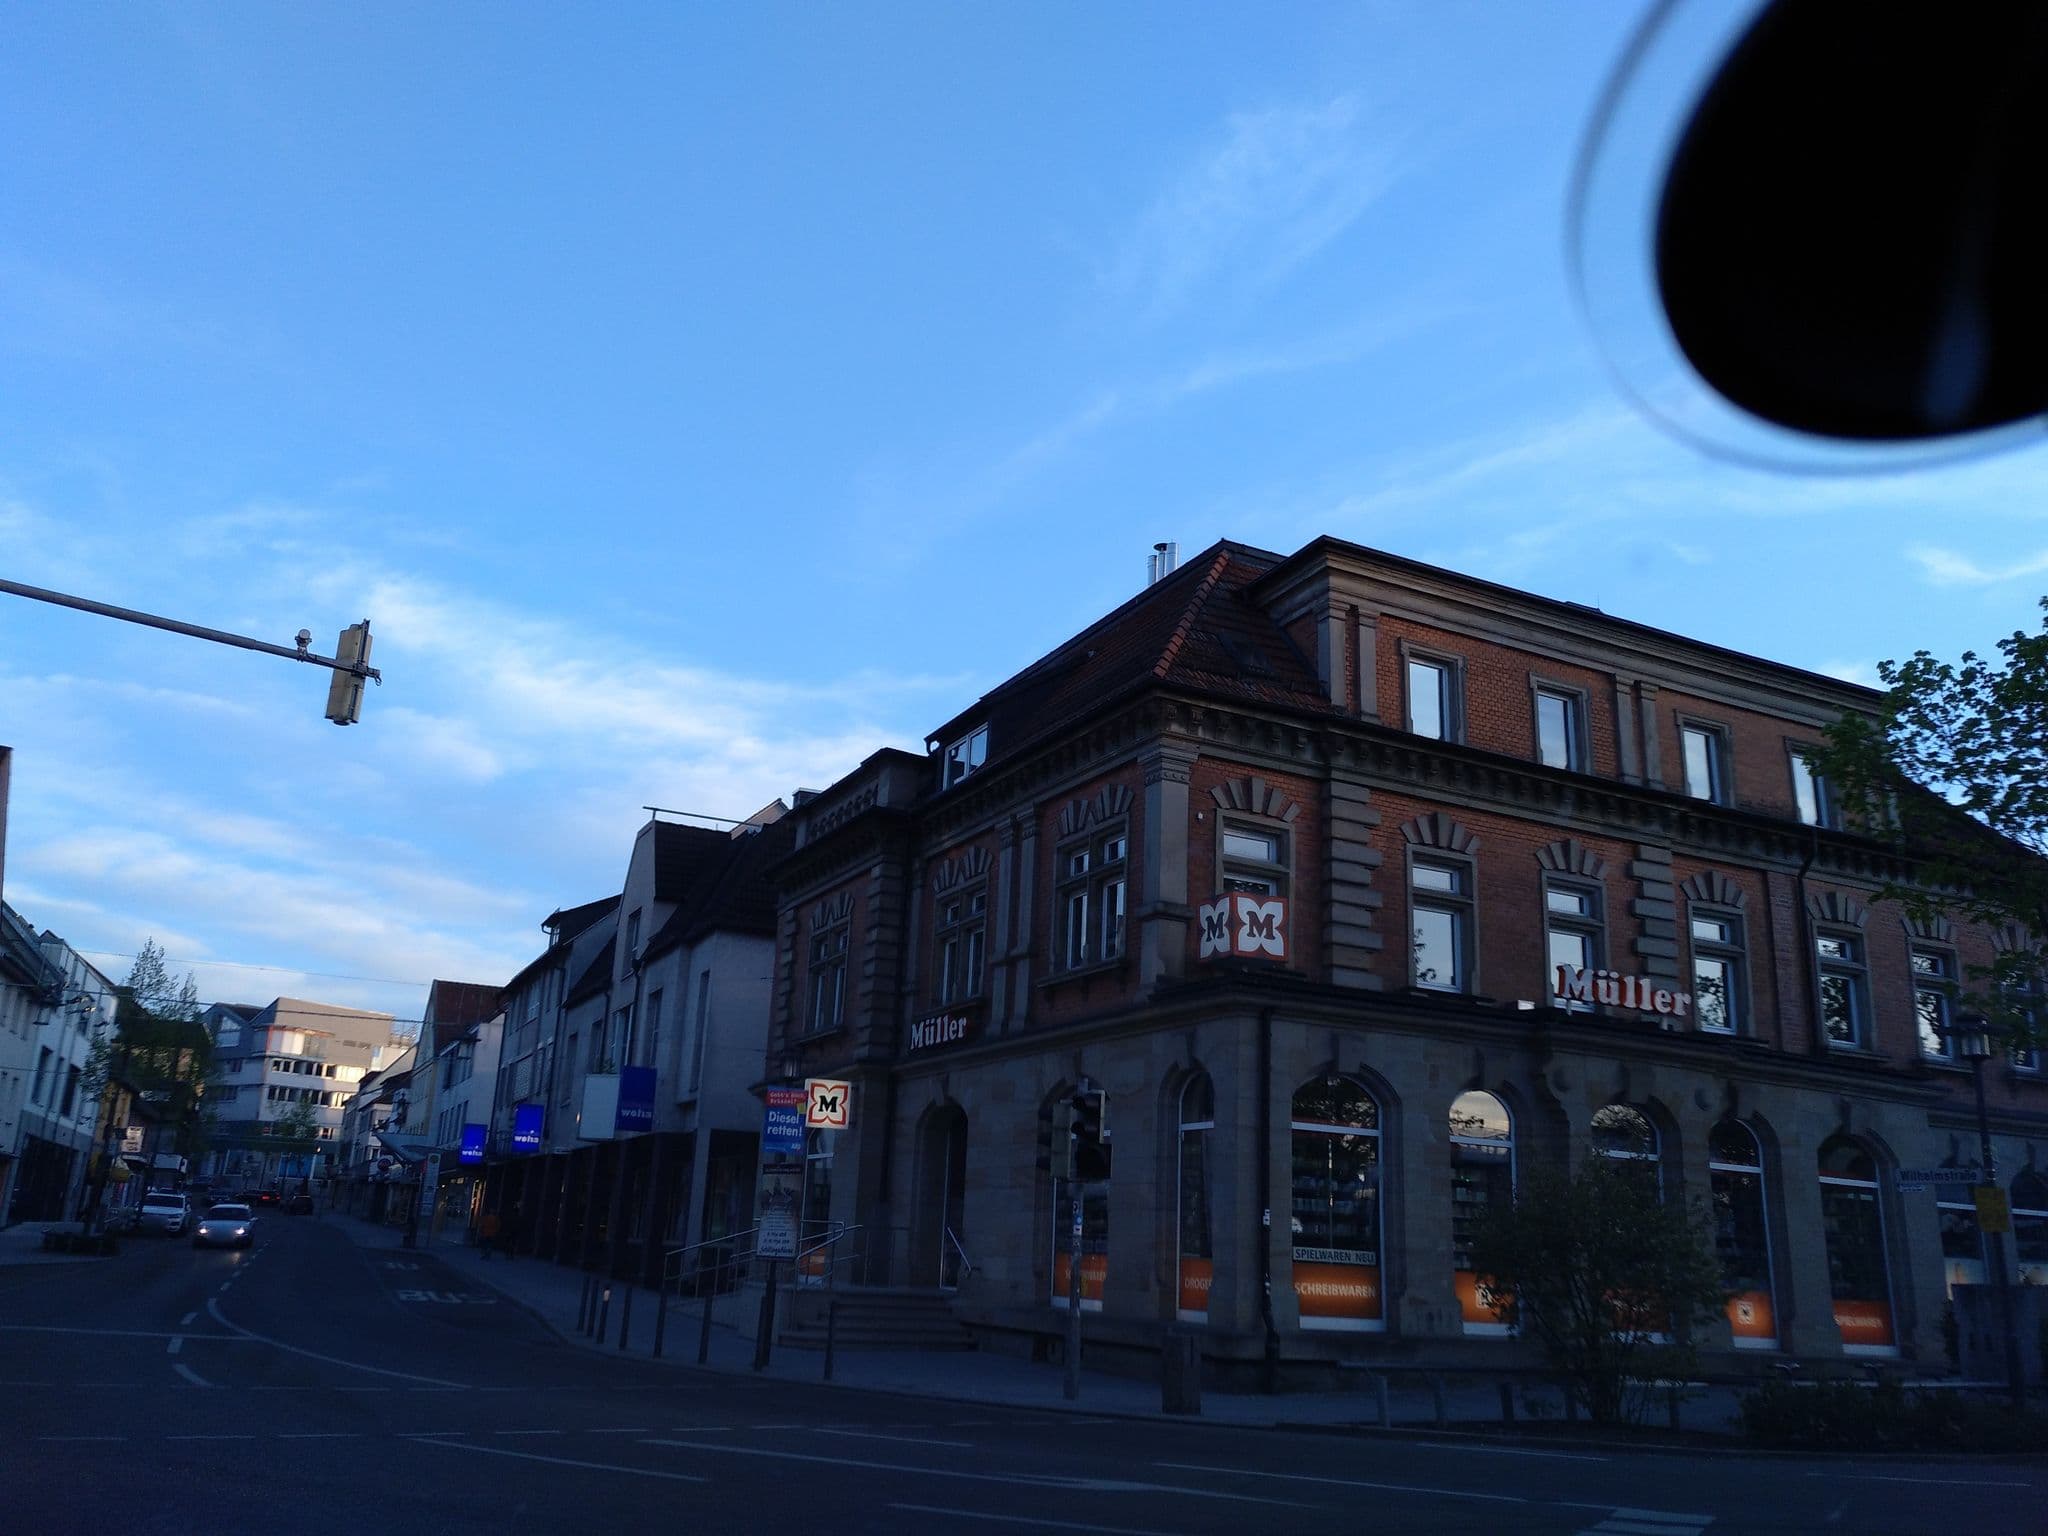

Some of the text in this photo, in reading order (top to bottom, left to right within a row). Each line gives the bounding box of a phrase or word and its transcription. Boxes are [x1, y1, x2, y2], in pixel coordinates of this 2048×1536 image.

[1206, 911, 1225, 942] M
[1246, 910, 1276, 940] M
[1556, 964, 1692, 1016] Müller
[910, 1014, 967, 1050] Müller
[818, 1095, 838, 1113] M
[768, 1110, 799, 1124] Diesel
[767, 1124, 802, 1137] retten!
[1295, 1248, 1375, 1264] SPIELWAREN NEU
[1294, 1281, 1377, 1299] SCHREIBWAREN
